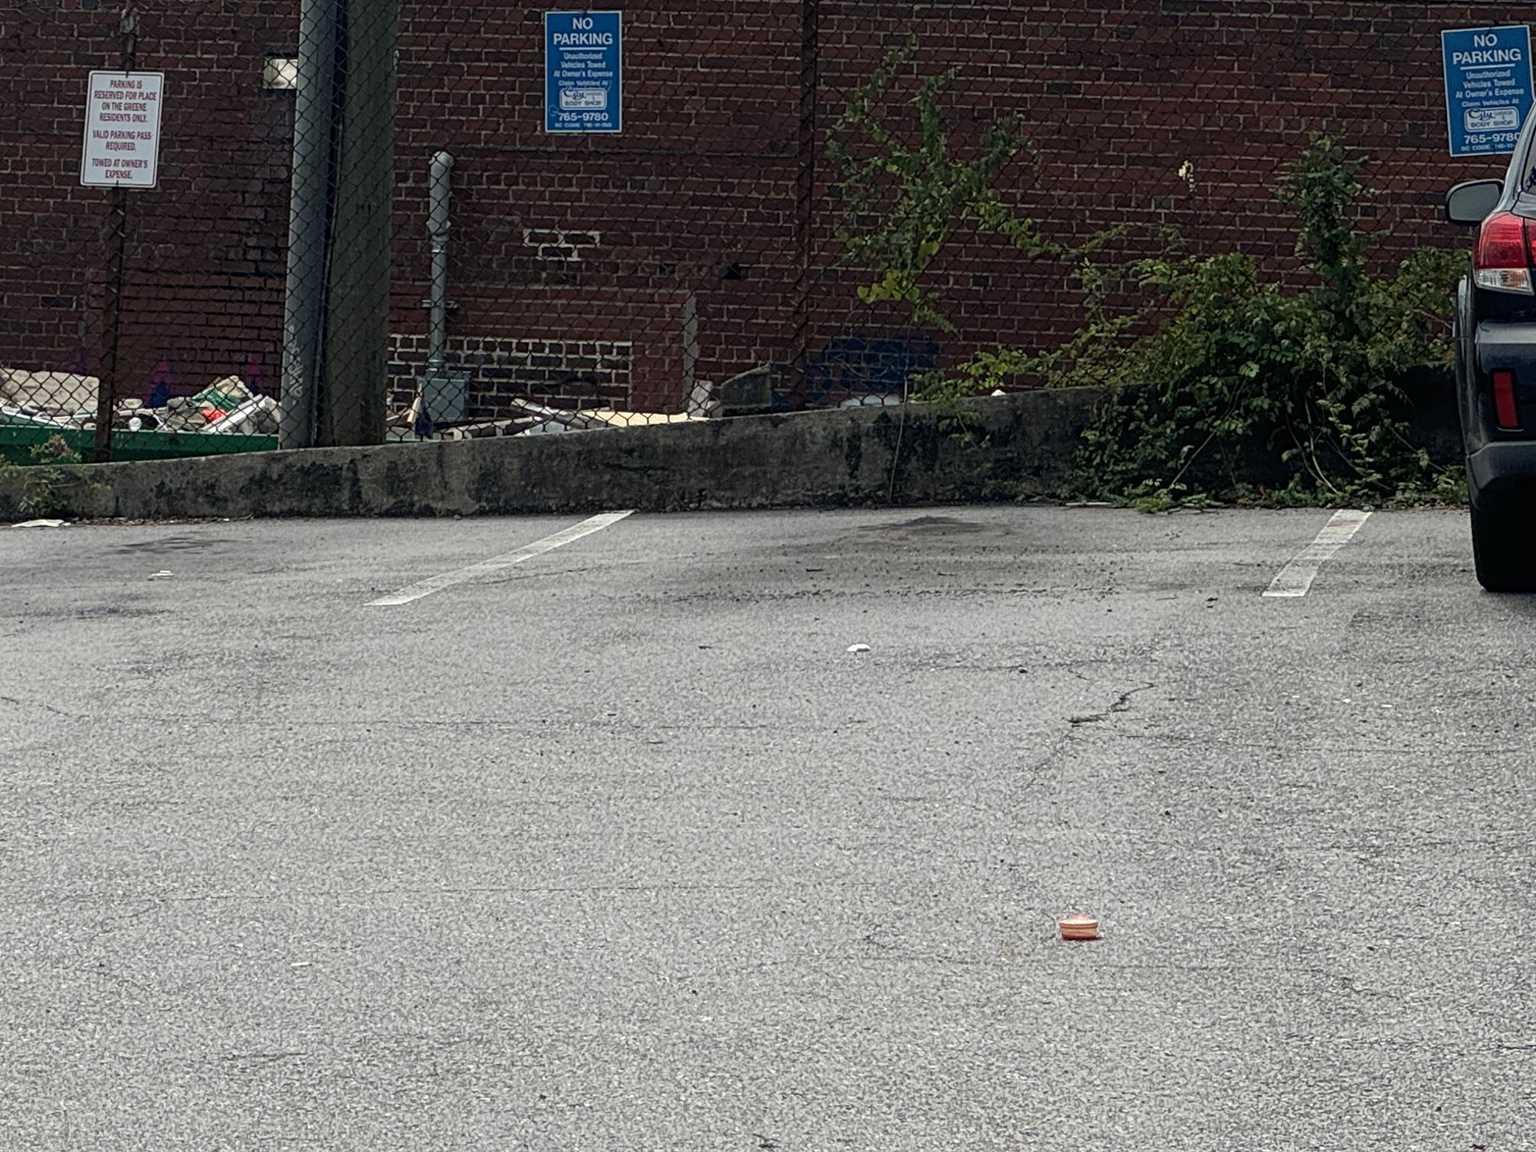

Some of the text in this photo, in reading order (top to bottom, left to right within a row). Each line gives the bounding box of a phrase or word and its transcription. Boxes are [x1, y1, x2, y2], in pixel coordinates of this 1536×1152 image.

[572, 17, 593, 30] NO
[553, 32, 613, 45] PARKING
[1473, 34, 1498, 47] NO
[1452, 48, 1522, 65] PARKING
[110, 79, 136, 89] PARKING
[94, 91, 158, 101] RESERVED FOR PLACE
[101, 102, 110, 111] ON
[111, 102, 123, 111] THE
[100, 113, 131, 122] RESIDENTS
[558, 112, 609, 121] 765-9780
[92, 130, 152, 140] VALID PARKING PASS
[1464, 132, 1521, 145] 765-9780
[92, 158, 112, 167] TOWED
[113, 158, 121, 168] AT
